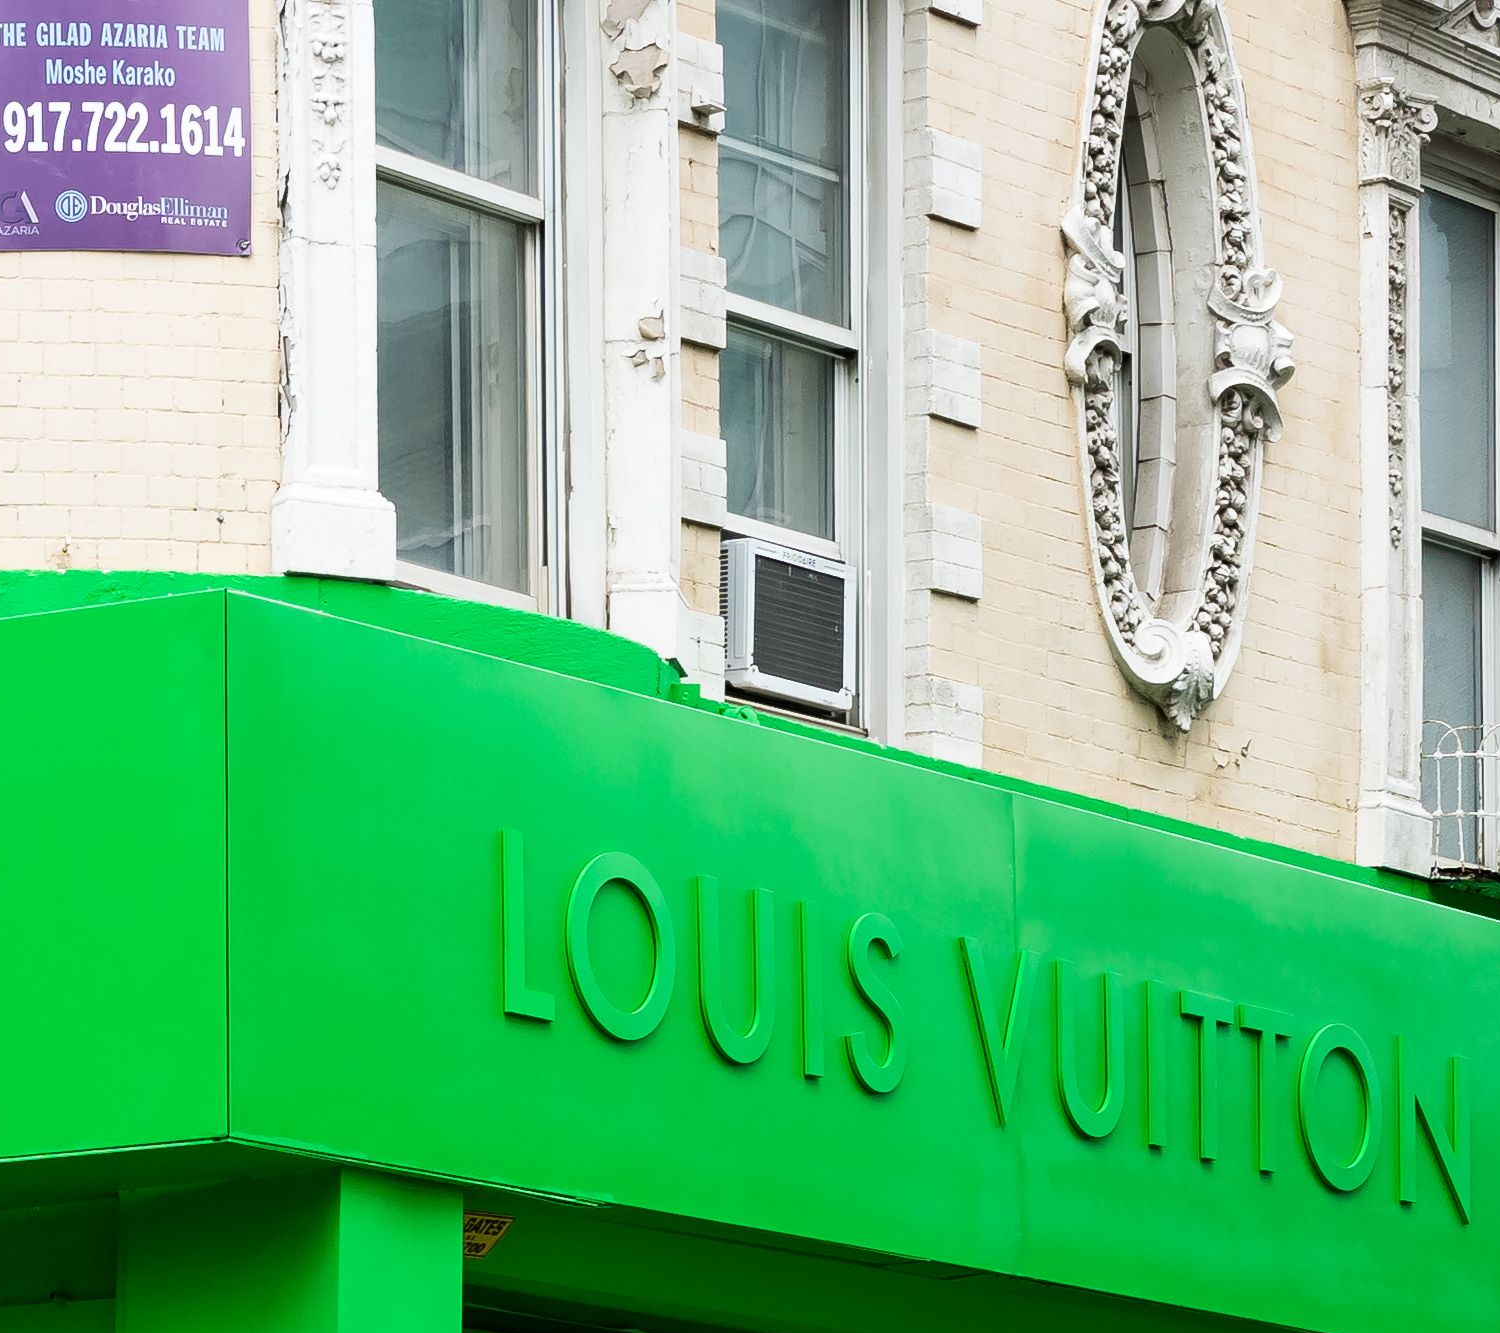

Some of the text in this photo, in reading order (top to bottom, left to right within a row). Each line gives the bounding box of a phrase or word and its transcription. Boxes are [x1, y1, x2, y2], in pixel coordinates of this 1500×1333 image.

[35, 22, 93, 48] GILAD
[99, 22, 169, 50] AZARIA
[175, 25, 226, 52] TEAM
[45, 58, 176, 88] Moshe Karako
[2, 101, 246, 158] 917.722.1614
[160, 216, 228, 228] REAL ESTATE
[500, 827, 1474, 1226] LOUIS VUITTON
